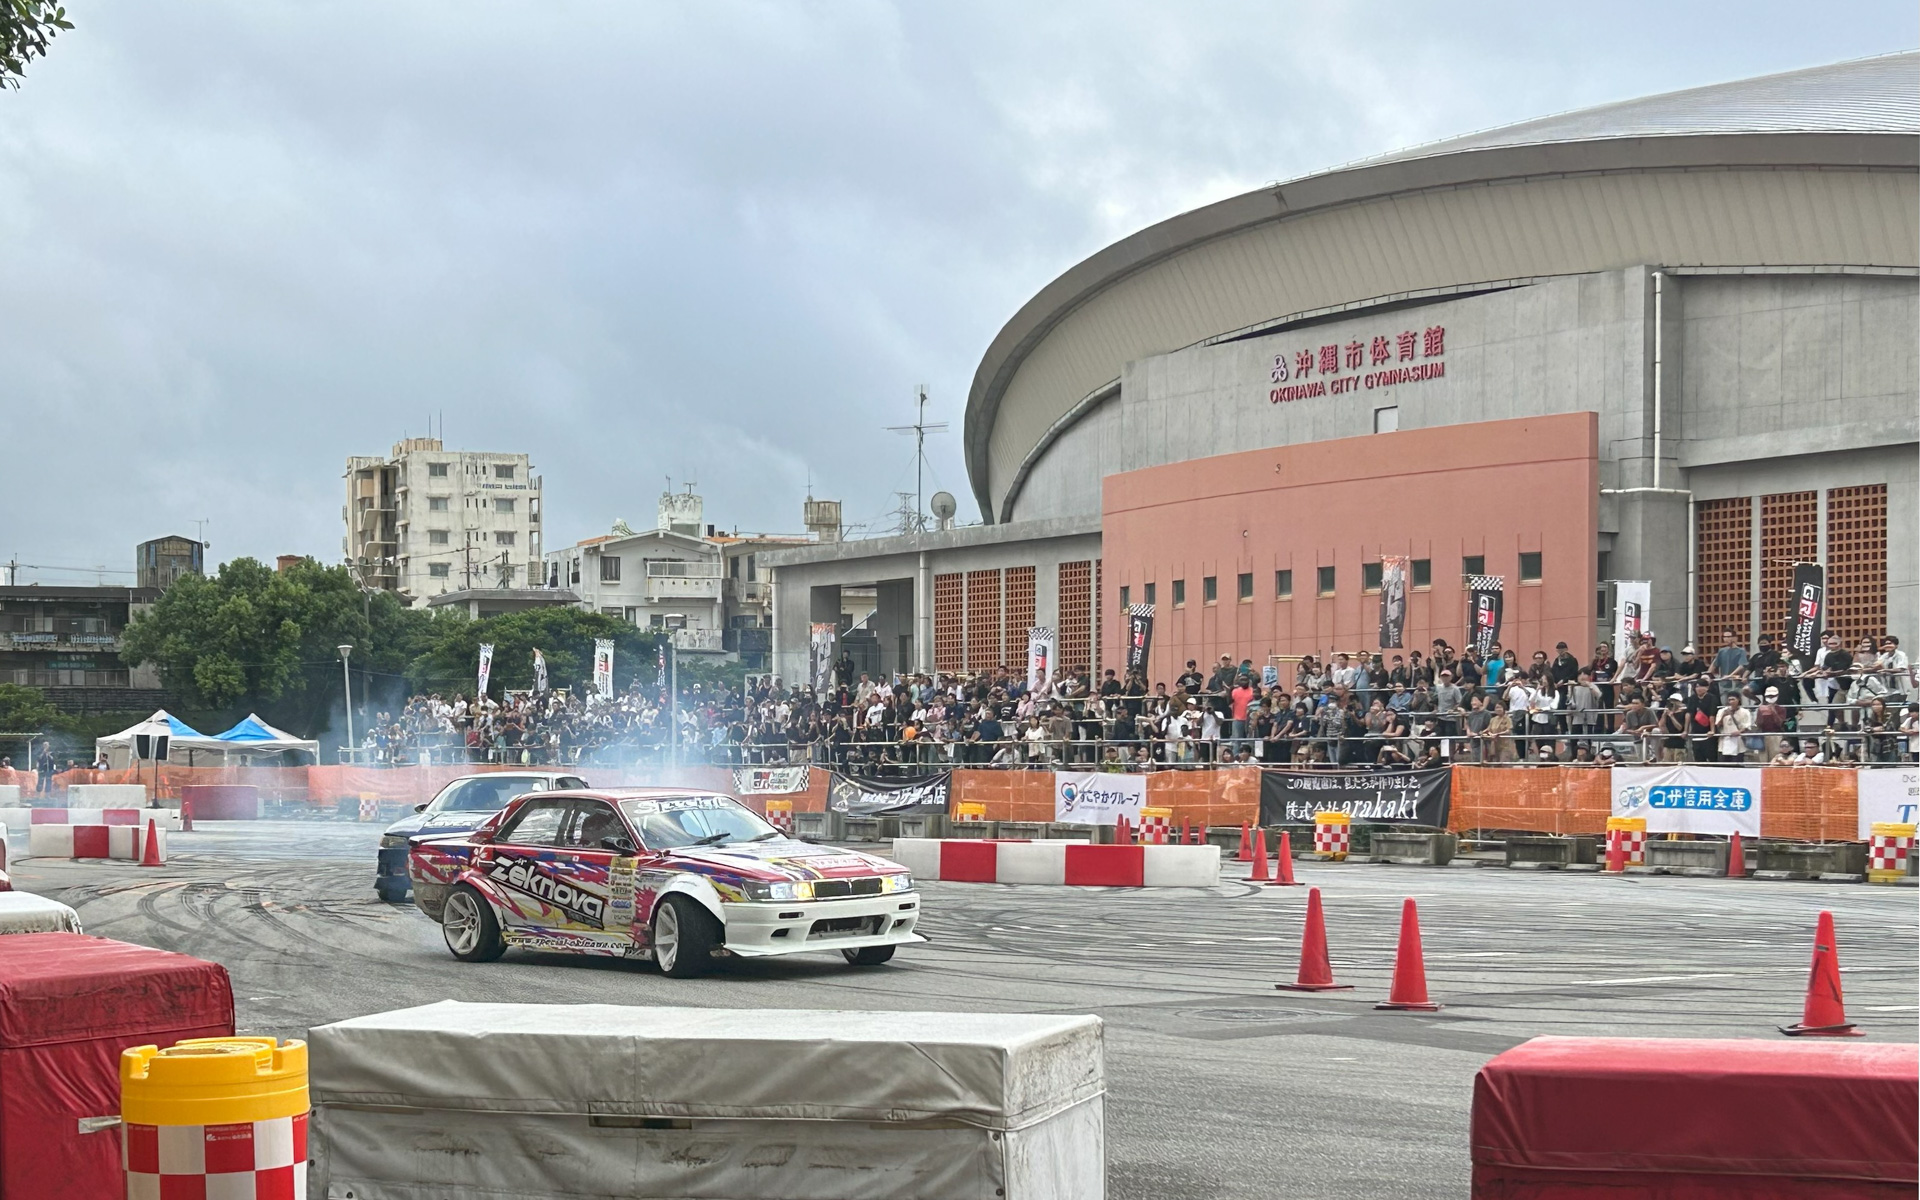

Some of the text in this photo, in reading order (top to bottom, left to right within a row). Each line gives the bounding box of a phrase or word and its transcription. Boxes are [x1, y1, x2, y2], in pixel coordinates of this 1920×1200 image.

[1294, 325, 1445, 379] 沖縄市体育館
[1270, 362, 1445, 404] OKINAWA CITY GYMNASIUM
[1478, 595, 1492, 626] GR
[1799, 584, 1818, 618] GR
[1079, 789, 1141, 806] すこやかグループ
[1653, 788, 1746, 810] コザ信用金庫
